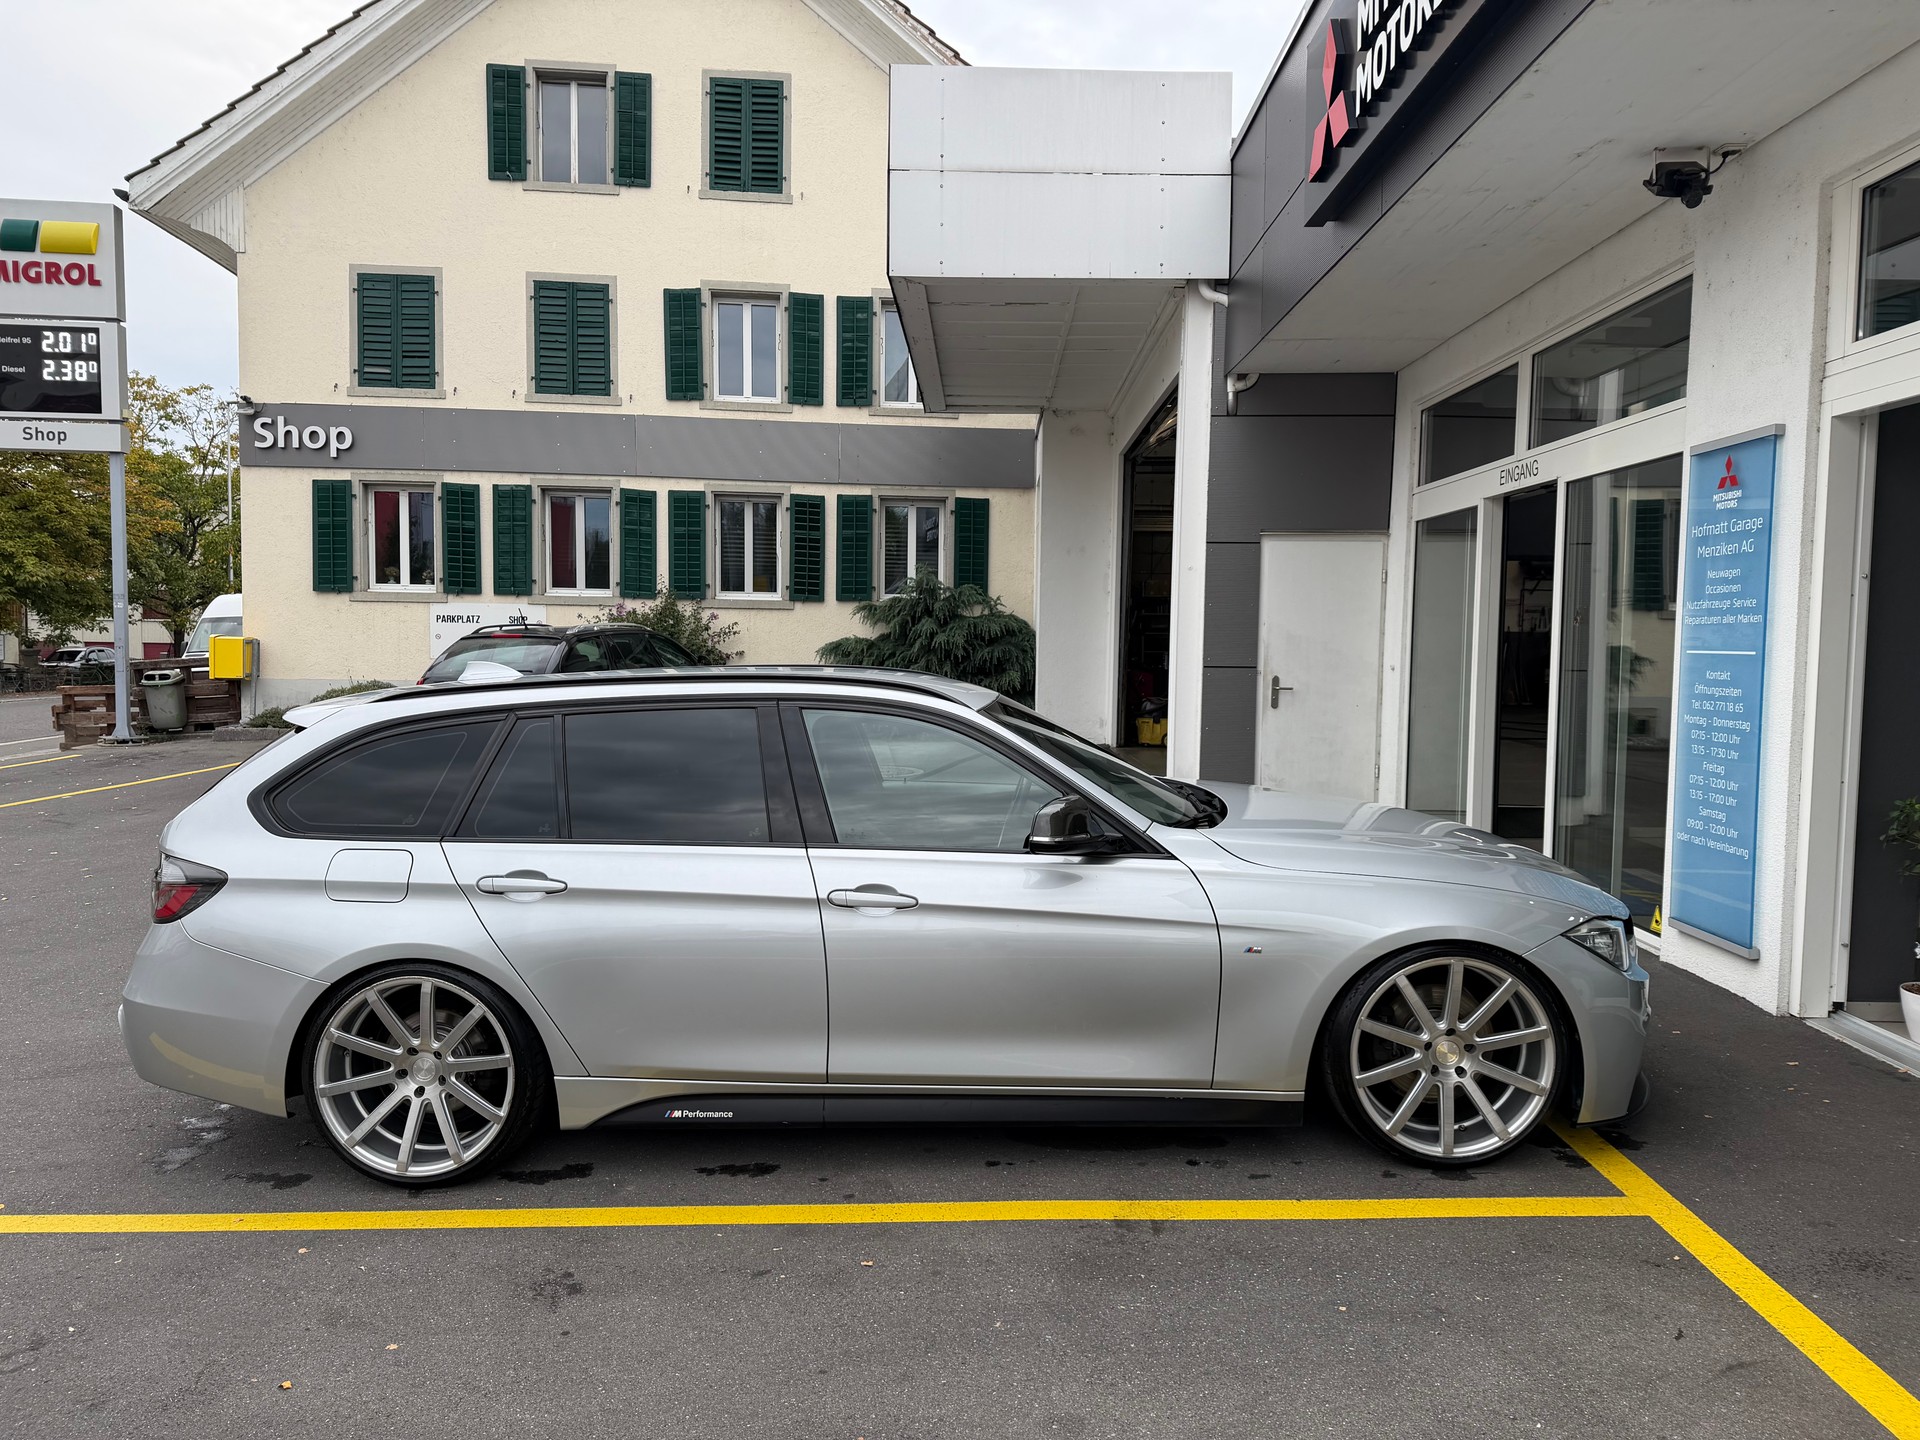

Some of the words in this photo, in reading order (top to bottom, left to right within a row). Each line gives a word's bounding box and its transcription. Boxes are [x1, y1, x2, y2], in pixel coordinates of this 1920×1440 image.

[1356, 0, 1443, 117] MOTOR
[1, 365, 26, 373] Diesel
[22, 426, 67, 445] Shop
[253, 415, 353, 458] Shop
[1500, 459, 1539, 486] EINGANG
[1713, 490, 1743, 502] MITSUBISHI
[1716, 500, 1738, 511] MOTORS
[1692, 522, 1728, 538] Hofmatt
[1730, 517, 1764, 533] Garage
[1697, 542, 1739, 559] Menziken
[1740, 538, 1755, 553] AG
[1707, 568, 1741, 580] Neuwagen
[1705, 583, 1742, 594] Occasionen
[1686, 599, 1731, 611] Nutzfahrzeuge
[1732, 597, 1757, 608] Service
[436, 614, 481, 624] PARKPLATZ
[508, 615, 528, 624] SHOP
[1684, 615, 1722, 627] Reparaturen
[1722, 613, 1737, 624] aller
[1737, 612, 1763, 624] Marken
[1706, 670, 1731, 680] Kontakt
[1694, 683, 1742, 697] Öffnungszeiten
[1702, 700, 1715, 711] 062
[1715, 701, 1726, 711] 771
[1726, 702, 1734, 712] 18
[1735, 702, 1744, 713] 65
[1684, 714, 1707, 728] Montag
[1713, 717, 1751, 732] Donnerstag
[1728, 734, 1741, 744] Uhr
[1727, 749, 1740, 760] Uhr
[1703, 762, 1725, 775] Freitag
[1726, 780, 1739, 791] Uhr
[1725, 796, 1738, 807] Uhr
[1699, 806, 1726, 822] Samstag
[1726, 827, 1739, 839] Uhr
[1676, 831, 1690, 841] oder
[1690, 834, 1706, 846] nach
[1706, 838, 1749, 860] Vereinbarung
[682, 1110, 733, 1118] Performance
